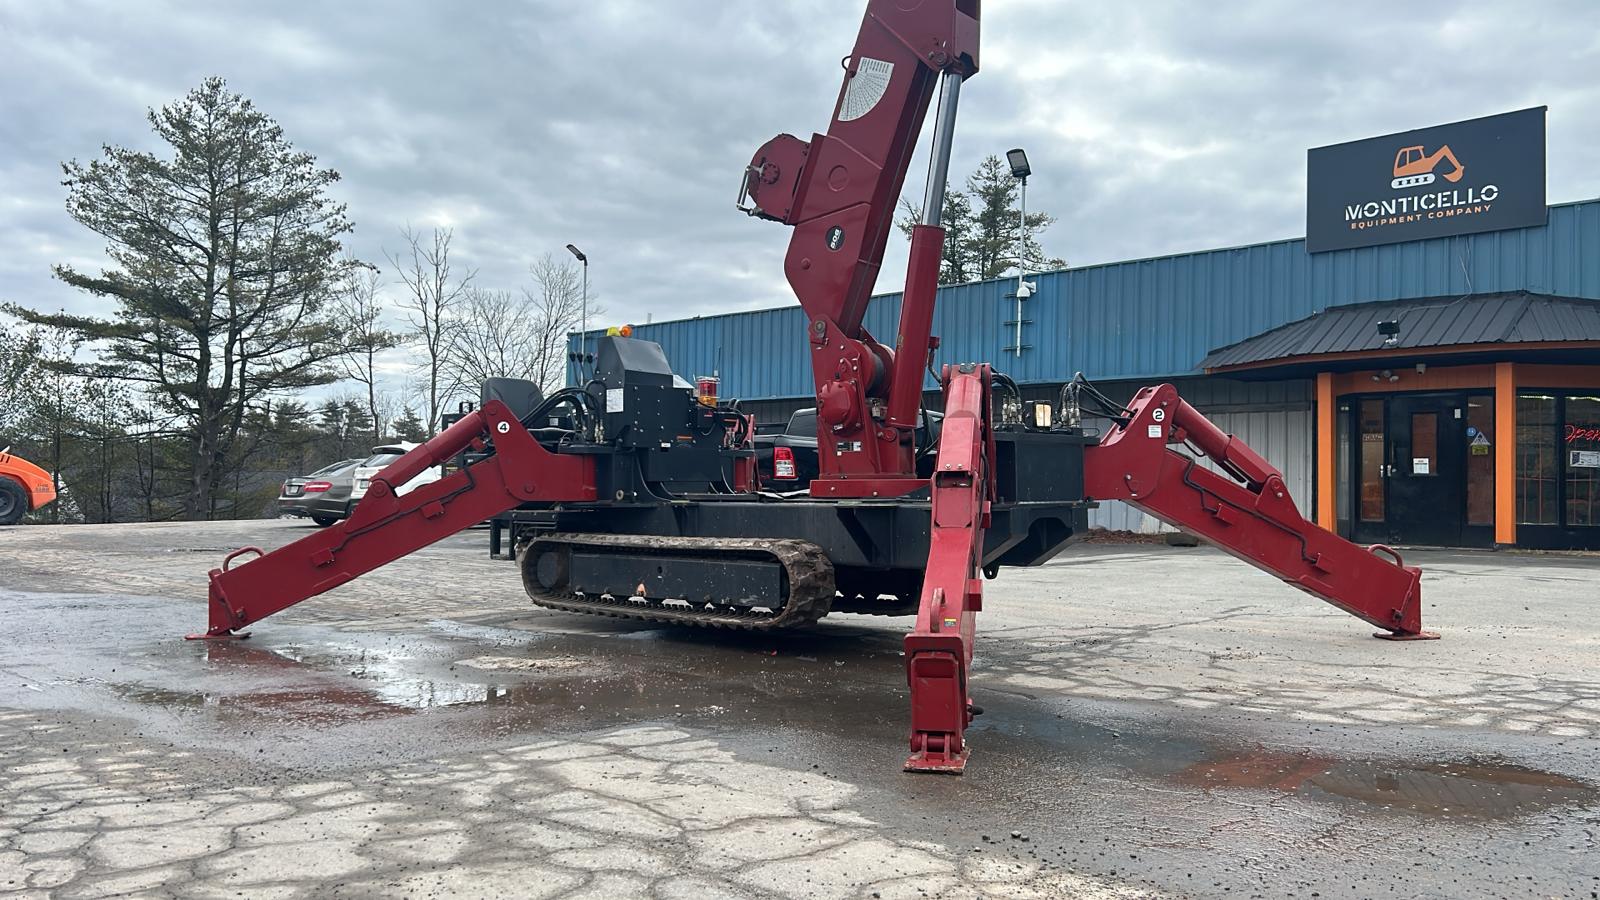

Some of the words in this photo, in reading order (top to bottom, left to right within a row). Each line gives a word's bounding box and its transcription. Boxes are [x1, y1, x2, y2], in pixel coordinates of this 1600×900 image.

[1345, 184, 1499, 221] MONTICELLO
[1351, 214, 1422, 230] EQUIPMENT
[1428, 204, 1491, 219] COMPANY
[1155, 410, 1163, 420] 2
